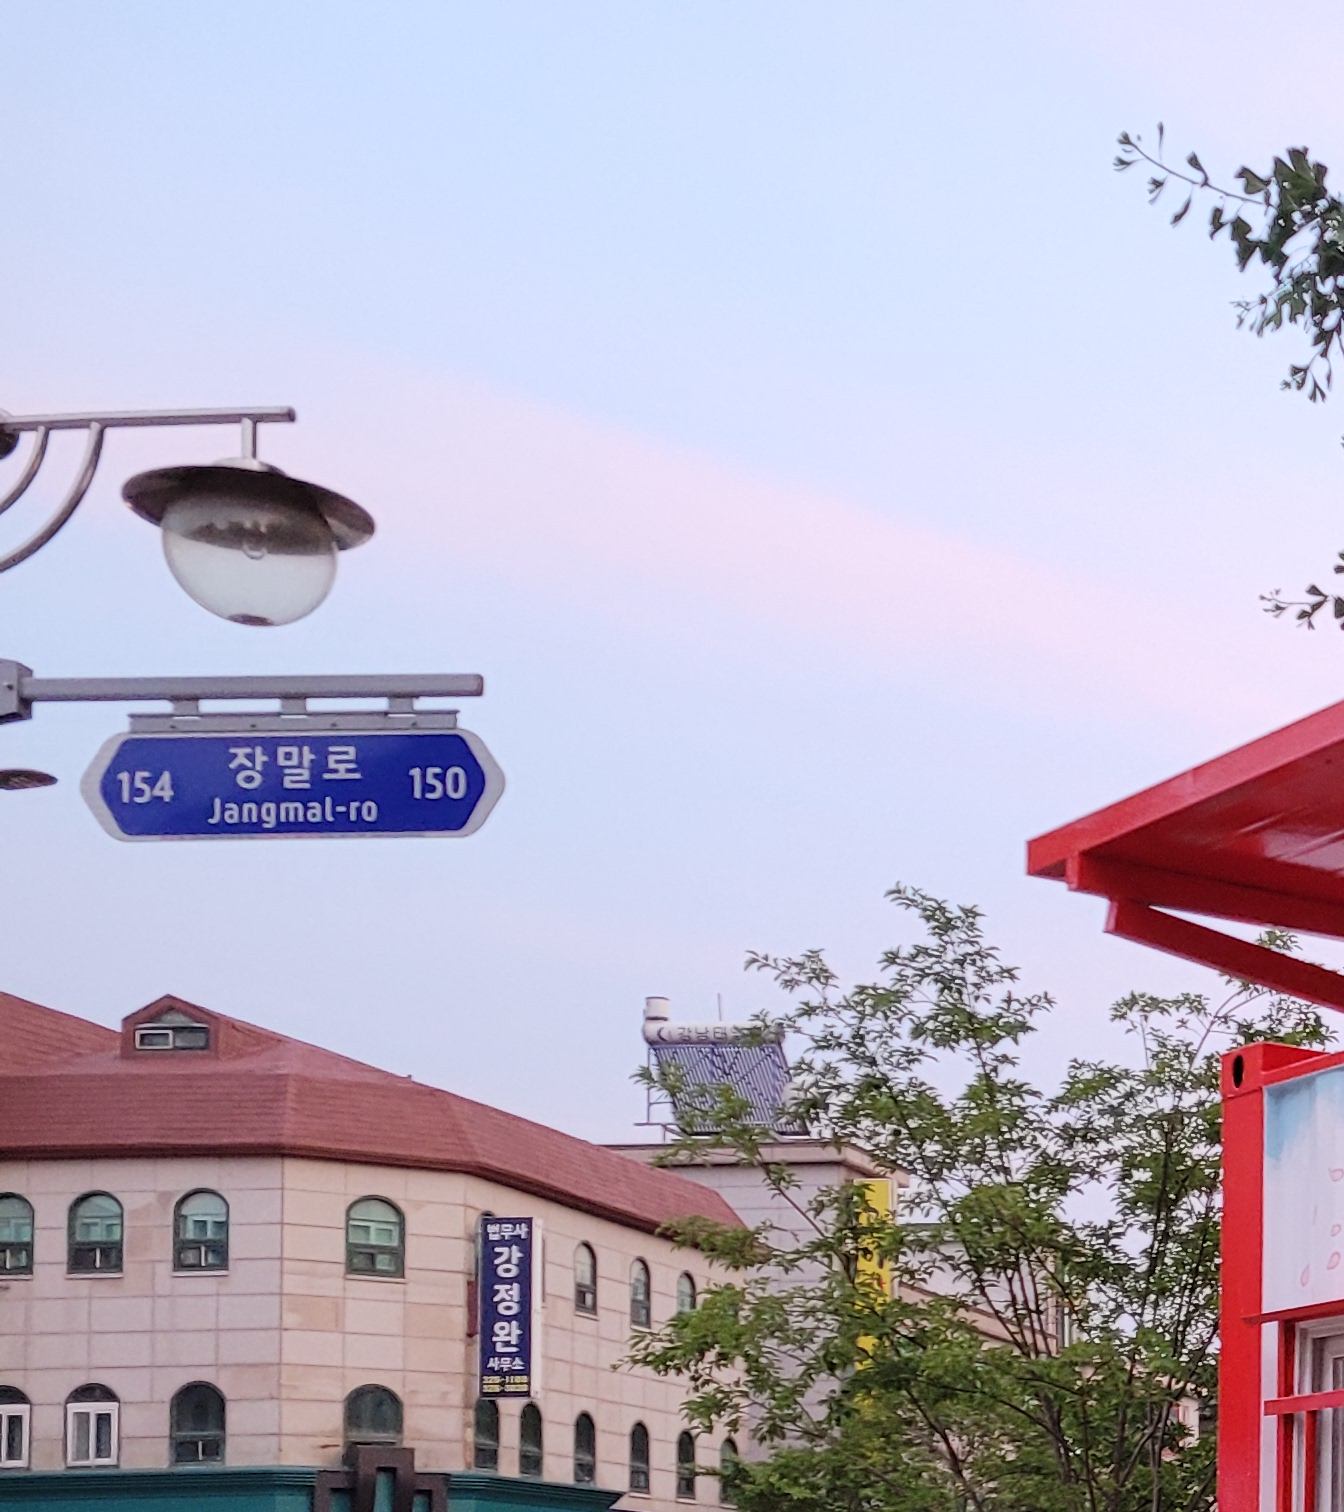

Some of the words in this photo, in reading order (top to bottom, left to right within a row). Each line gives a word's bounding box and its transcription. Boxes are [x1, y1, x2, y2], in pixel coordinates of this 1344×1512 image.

[228, 745, 362, 790] 장말로
[408, 766, 468, 800] 150
[116, 771, 174, 803] 154
[207, 797, 378, 829] Jangmal-ro
[486, 1223, 529, 1240] 법무사
[492, 1244, 524, 1353] 강정완
[486, 1356, 525, 1372] 사무소
